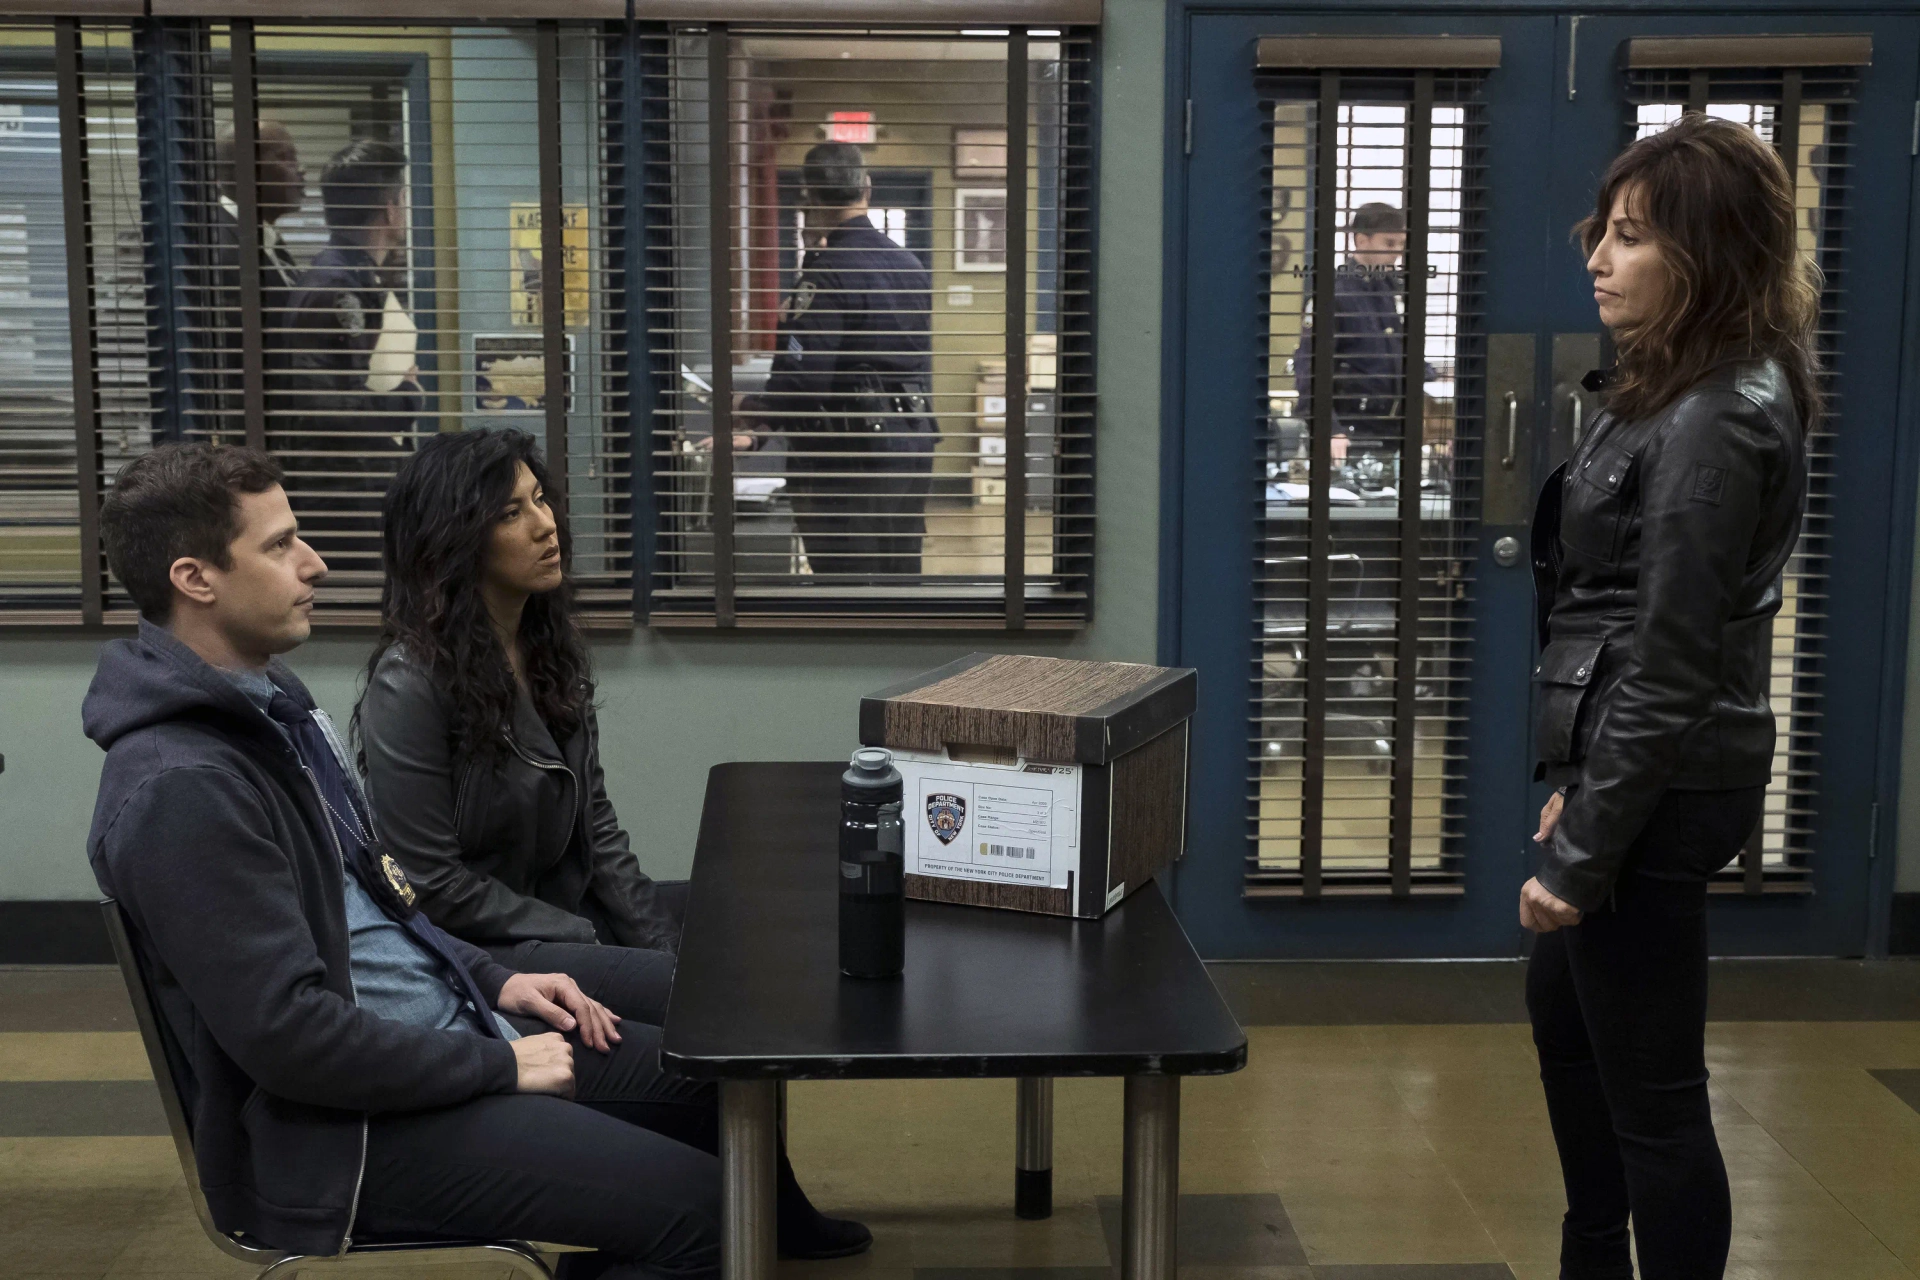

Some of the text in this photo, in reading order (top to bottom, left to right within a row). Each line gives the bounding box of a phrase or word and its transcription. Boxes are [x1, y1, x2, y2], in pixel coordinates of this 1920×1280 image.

[935, 795, 957, 803] POLICE
[928, 801, 965, 813] DEPARTMENT
[924, 863, 947, 871] PROPERTY
[1015, 873, 1045, 881] DEPARTMENT
